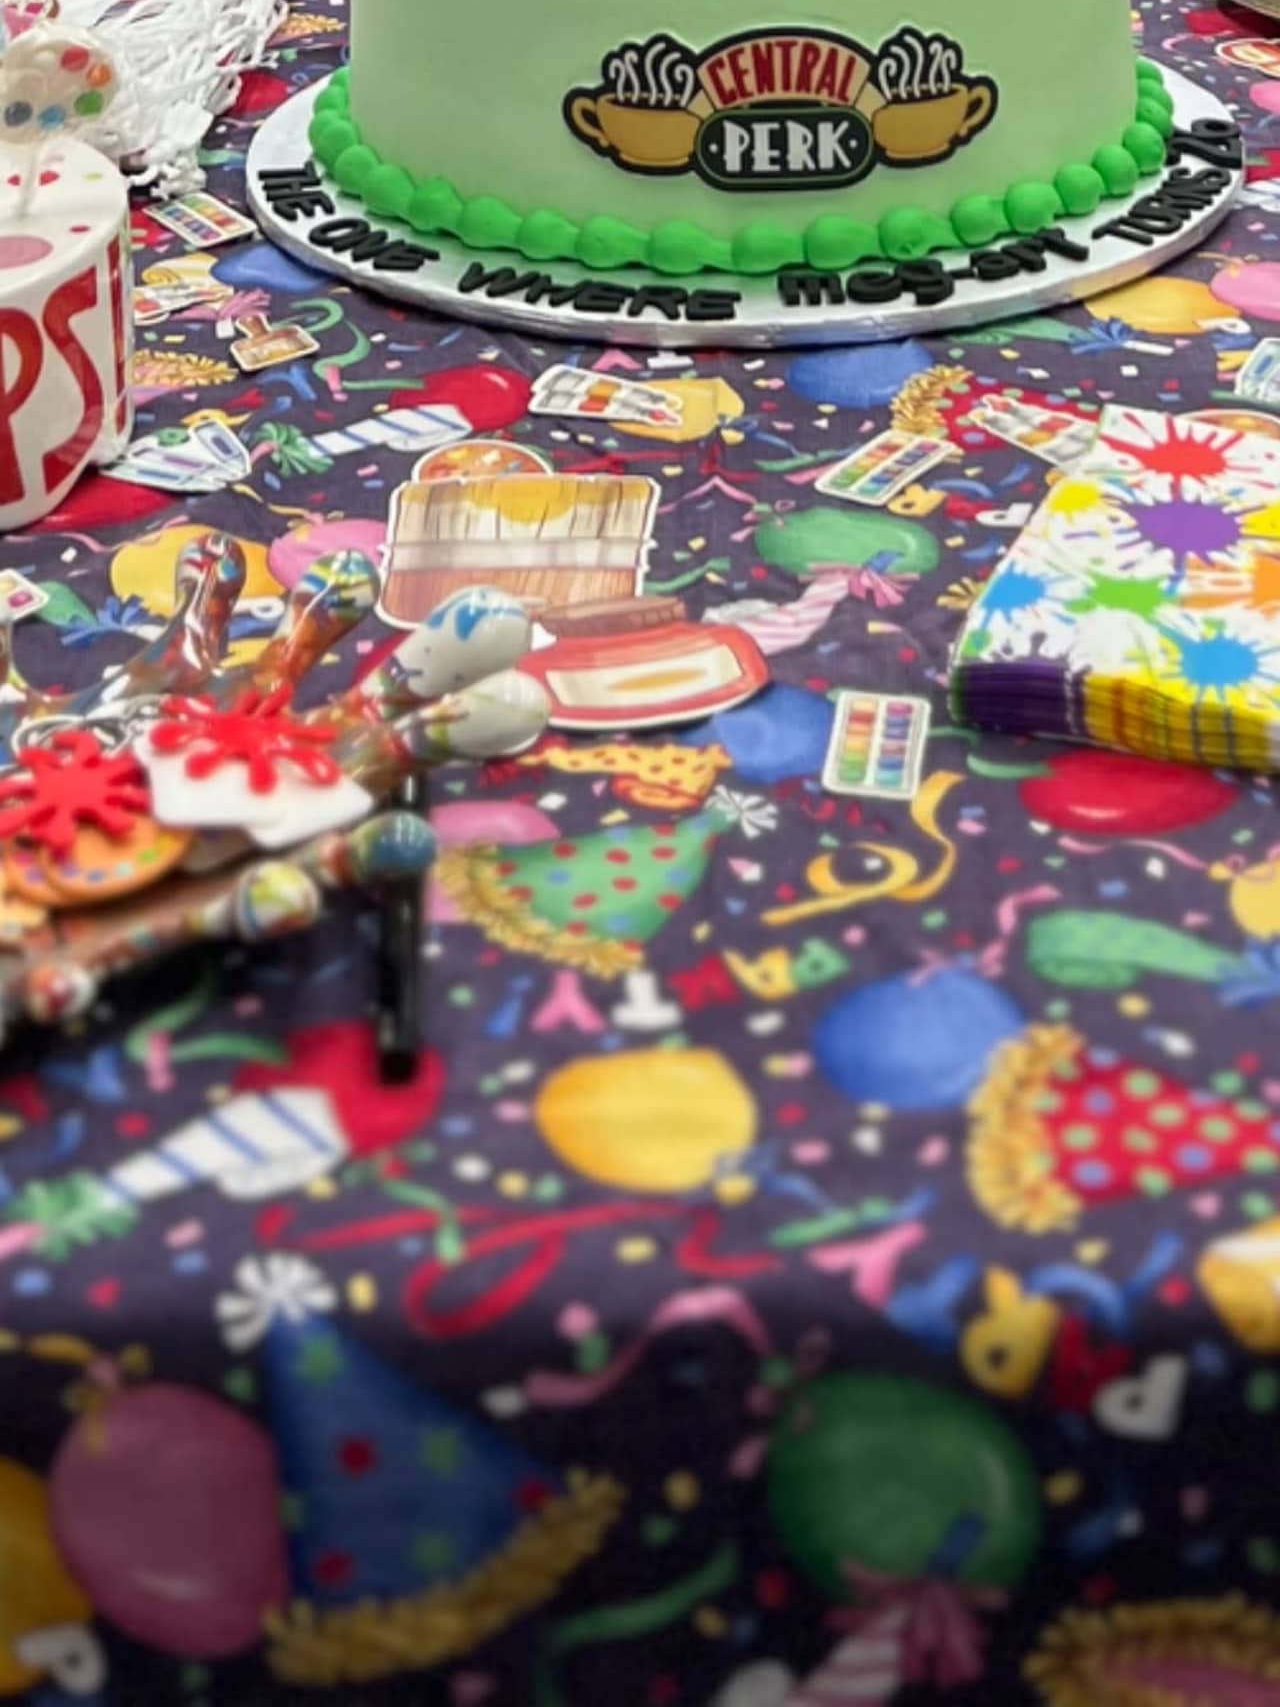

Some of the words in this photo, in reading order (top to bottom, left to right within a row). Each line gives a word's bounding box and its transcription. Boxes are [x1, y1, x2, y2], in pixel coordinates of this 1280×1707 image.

[705, 40, 857, 107] CENTRAL
[722, 119, 852, 173] PERK
[258, 160, 335, 222] THE
[309, 217, 440, 271] ONE
[457, 261, 742, 321] WHERE
[1091, 165, 1232, 246] TURNS
